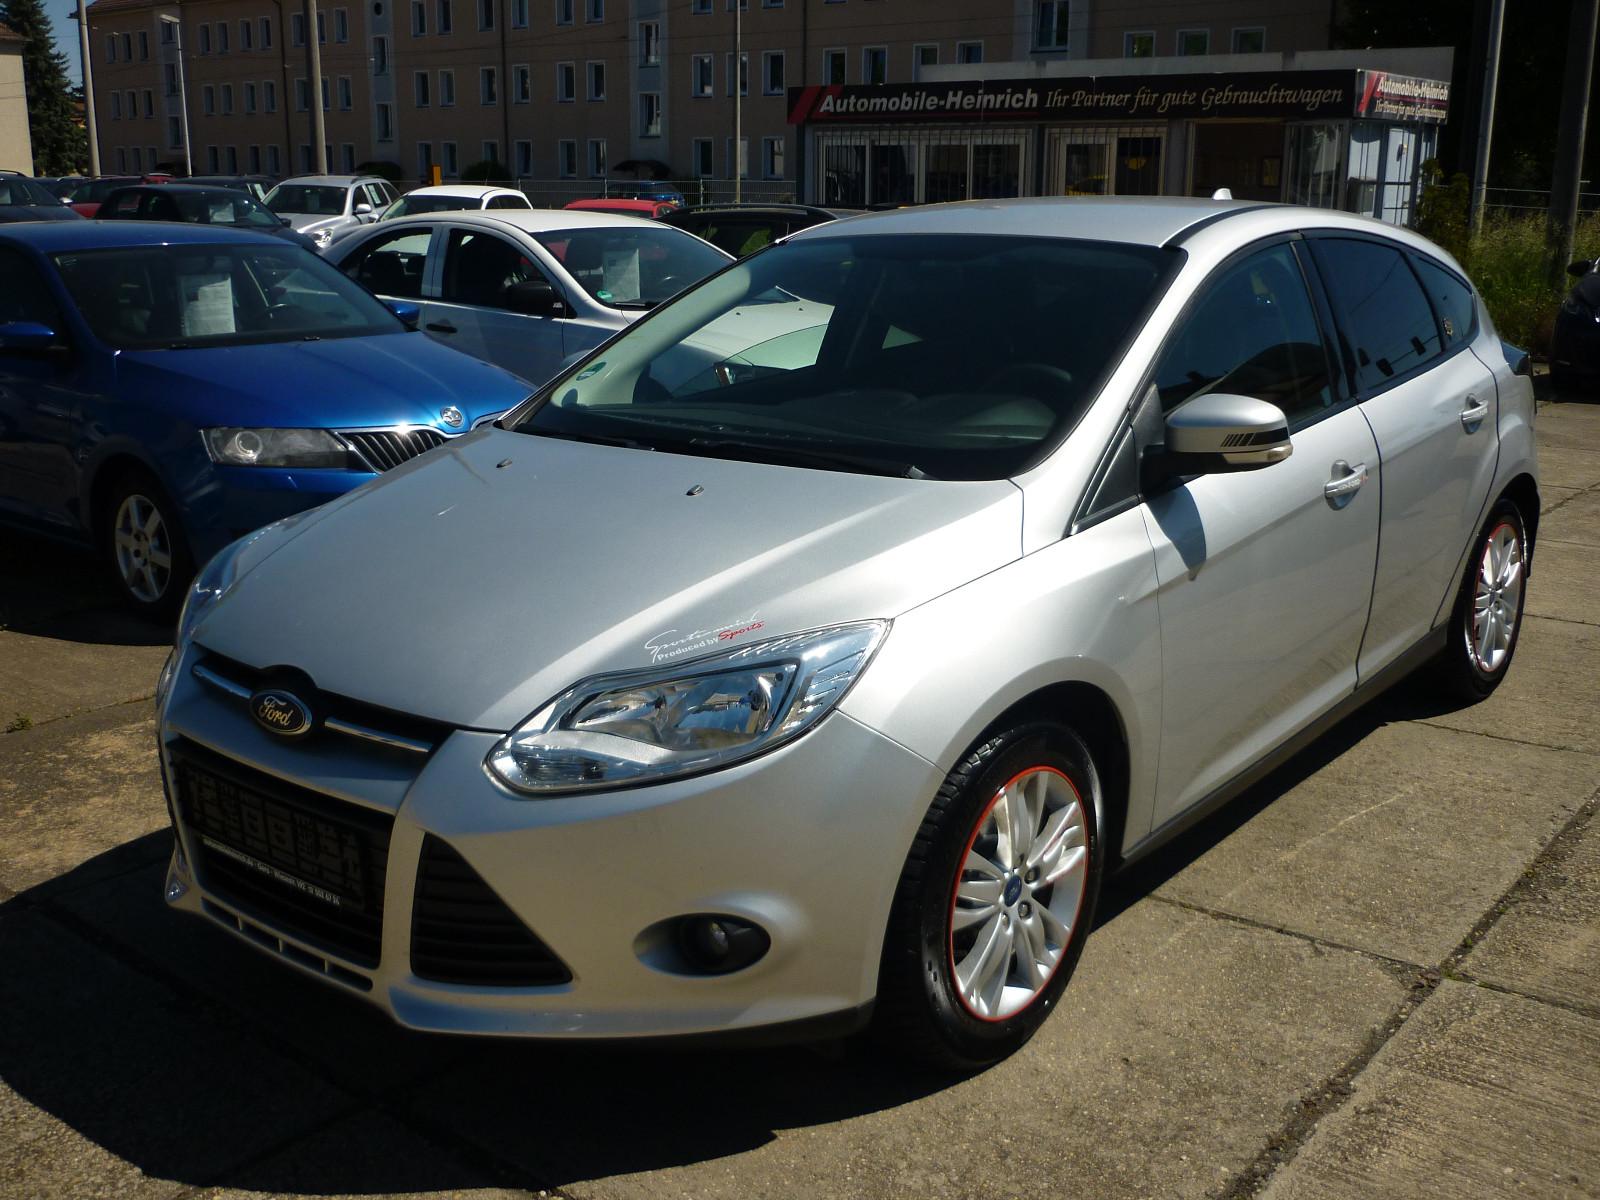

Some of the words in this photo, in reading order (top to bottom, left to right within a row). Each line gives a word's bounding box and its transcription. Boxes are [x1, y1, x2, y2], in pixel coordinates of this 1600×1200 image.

[819, 88, 1039, 112] Automobile-Heinrich
[1045, 90, 1069, 108] Ihr
[1072, 88, 1130, 108] Partner
[1129, 86, 1159, 113] für
[1158, 89, 1196, 113] gute
[1201, 83, 1343, 110] Gebrauchtwagen
[657, 641, 706, 661] Produced
[706, 636, 720, 646] by
[718, 620, 765, 640] Sports
[258, 696, 294, 726] Ford
